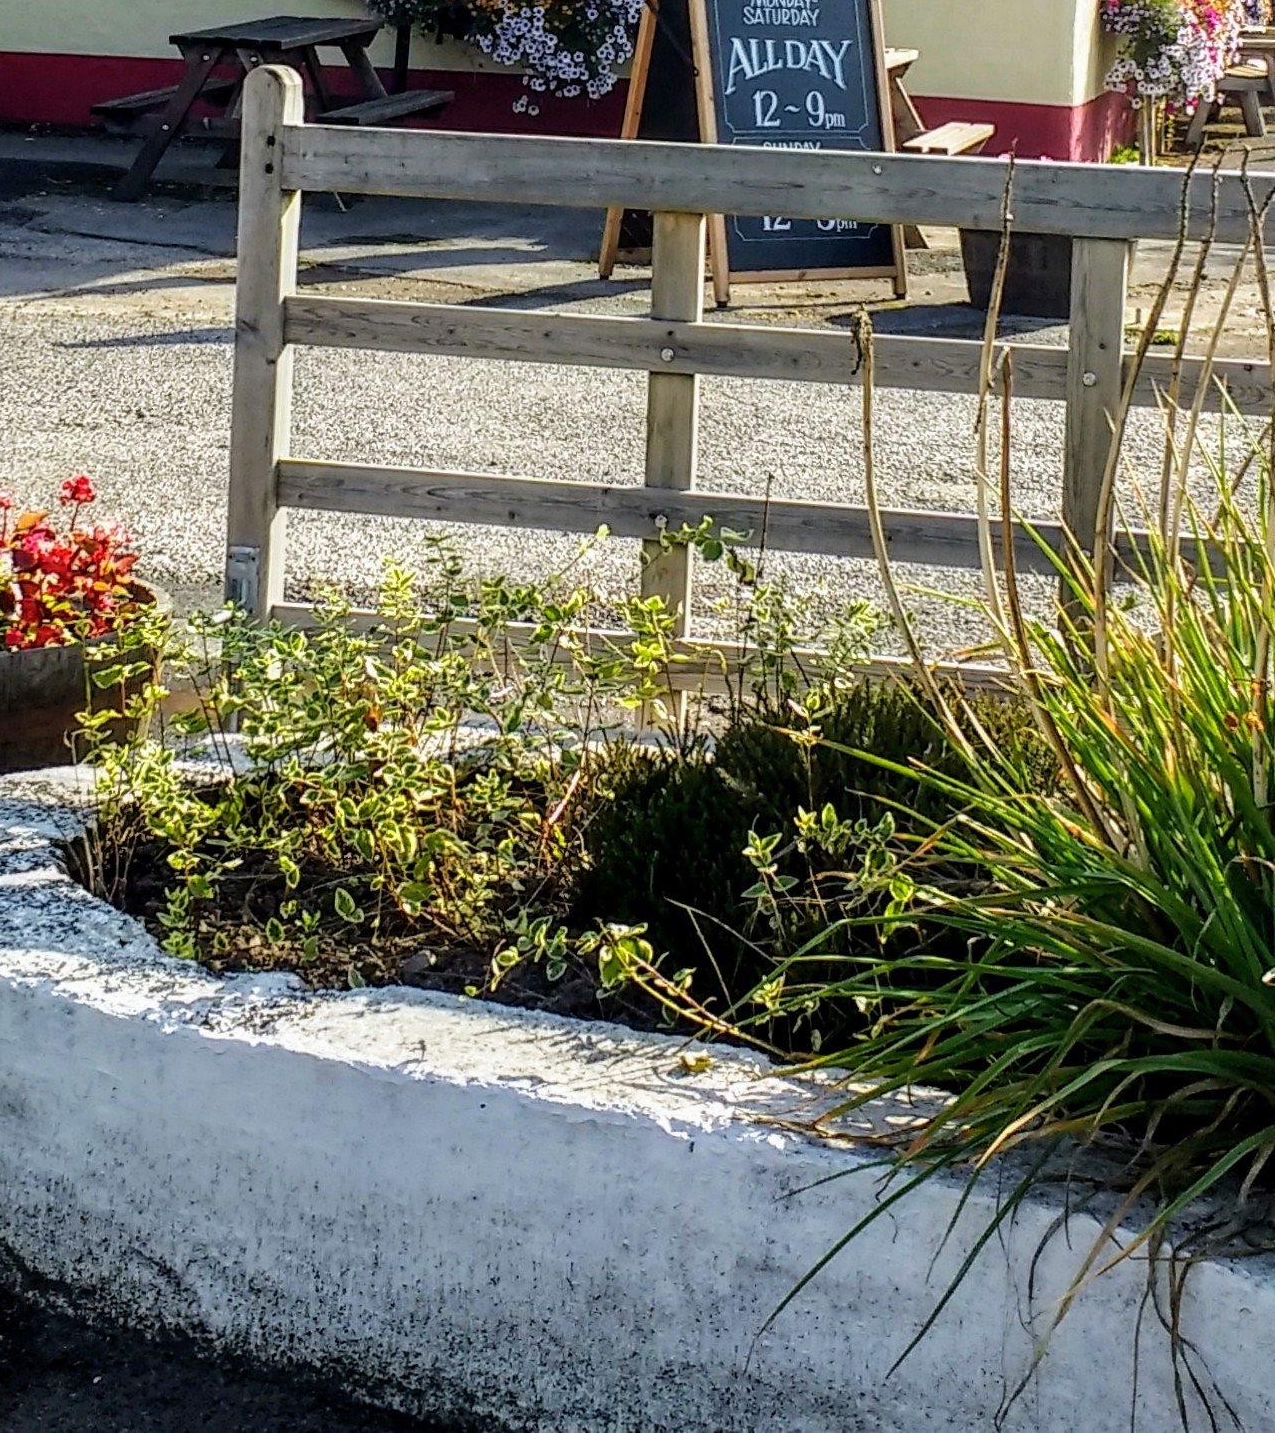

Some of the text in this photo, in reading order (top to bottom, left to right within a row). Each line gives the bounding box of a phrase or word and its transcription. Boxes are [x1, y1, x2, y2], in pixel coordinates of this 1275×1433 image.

[743, 6, 820, 27] SATURDAY
[725, 37, 853, 95] ALL DAY
[752, 90, 782, 127] 12
[805, 90, 846, 129] 9pm
